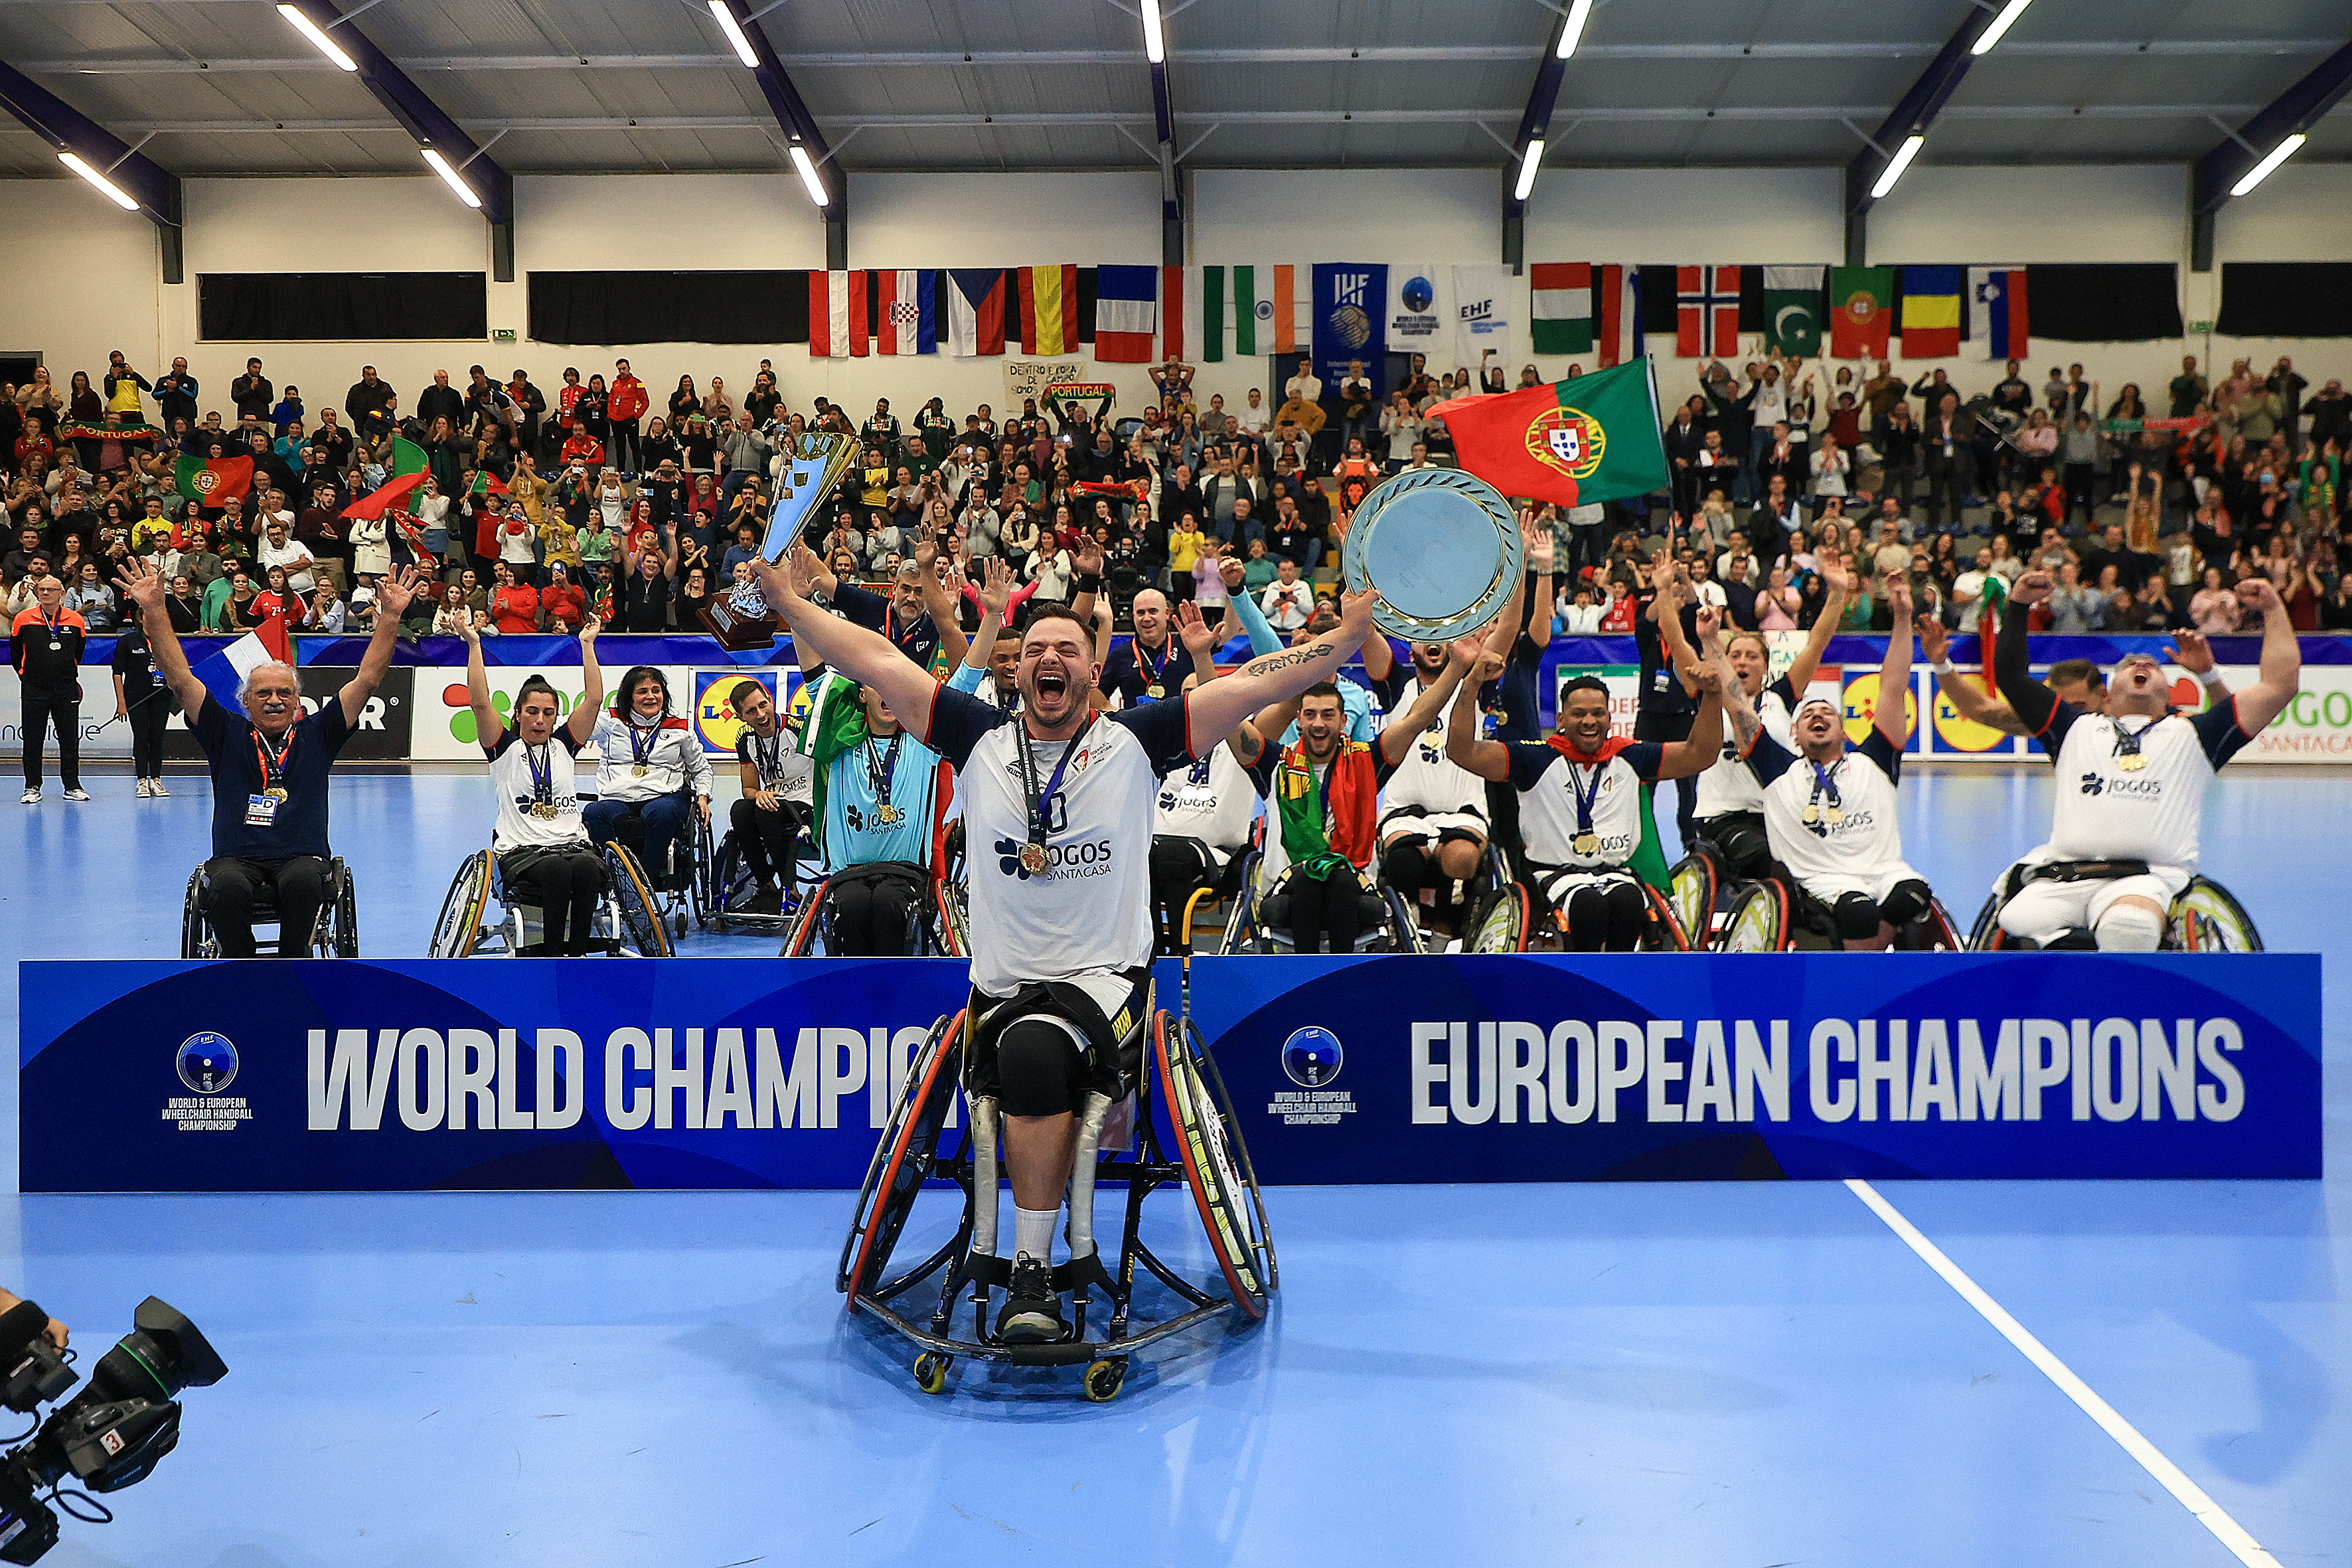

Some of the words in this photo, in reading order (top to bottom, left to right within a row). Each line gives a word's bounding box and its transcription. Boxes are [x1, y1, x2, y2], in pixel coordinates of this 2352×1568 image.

[1334, 274, 1370, 306] IHF
[1461, 300, 1492, 318] EHF
[1010, 365, 1045, 375] DENTRO
[1028, 376, 1038, 384] DE
[1051, 385, 1105, 396] PORTUGAL
[77, 424, 150, 438] PORTUGAL
[2107, 779, 2160, 795] JOGOS
[866, 808, 905, 830] JOOS
[1048, 840, 1111, 867] OGOS
[1047, 864, 1112, 881] SANTACASA
[308, 1028, 584, 1131] WORLD
[605, 1027, 957, 1130] CHAMPIO
[1411, 1020, 1790, 1125] EUROPEAN
[1809, 1017, 2245, 1123] CHAMPIONS
[169, 1097, 198, 1108] WORLD
[199, 1097, 205, 1108] &
[206, 1097, 246, 1108] EUROPEAN
[161, 1109, 212, 1119] WHEELCHAIR
[213, 1109, 253, 1119] HANDBALL
[178, 1120, 237, 1131] CHAMPIONSHIP
[105, 1433, 121, 1451] 3
